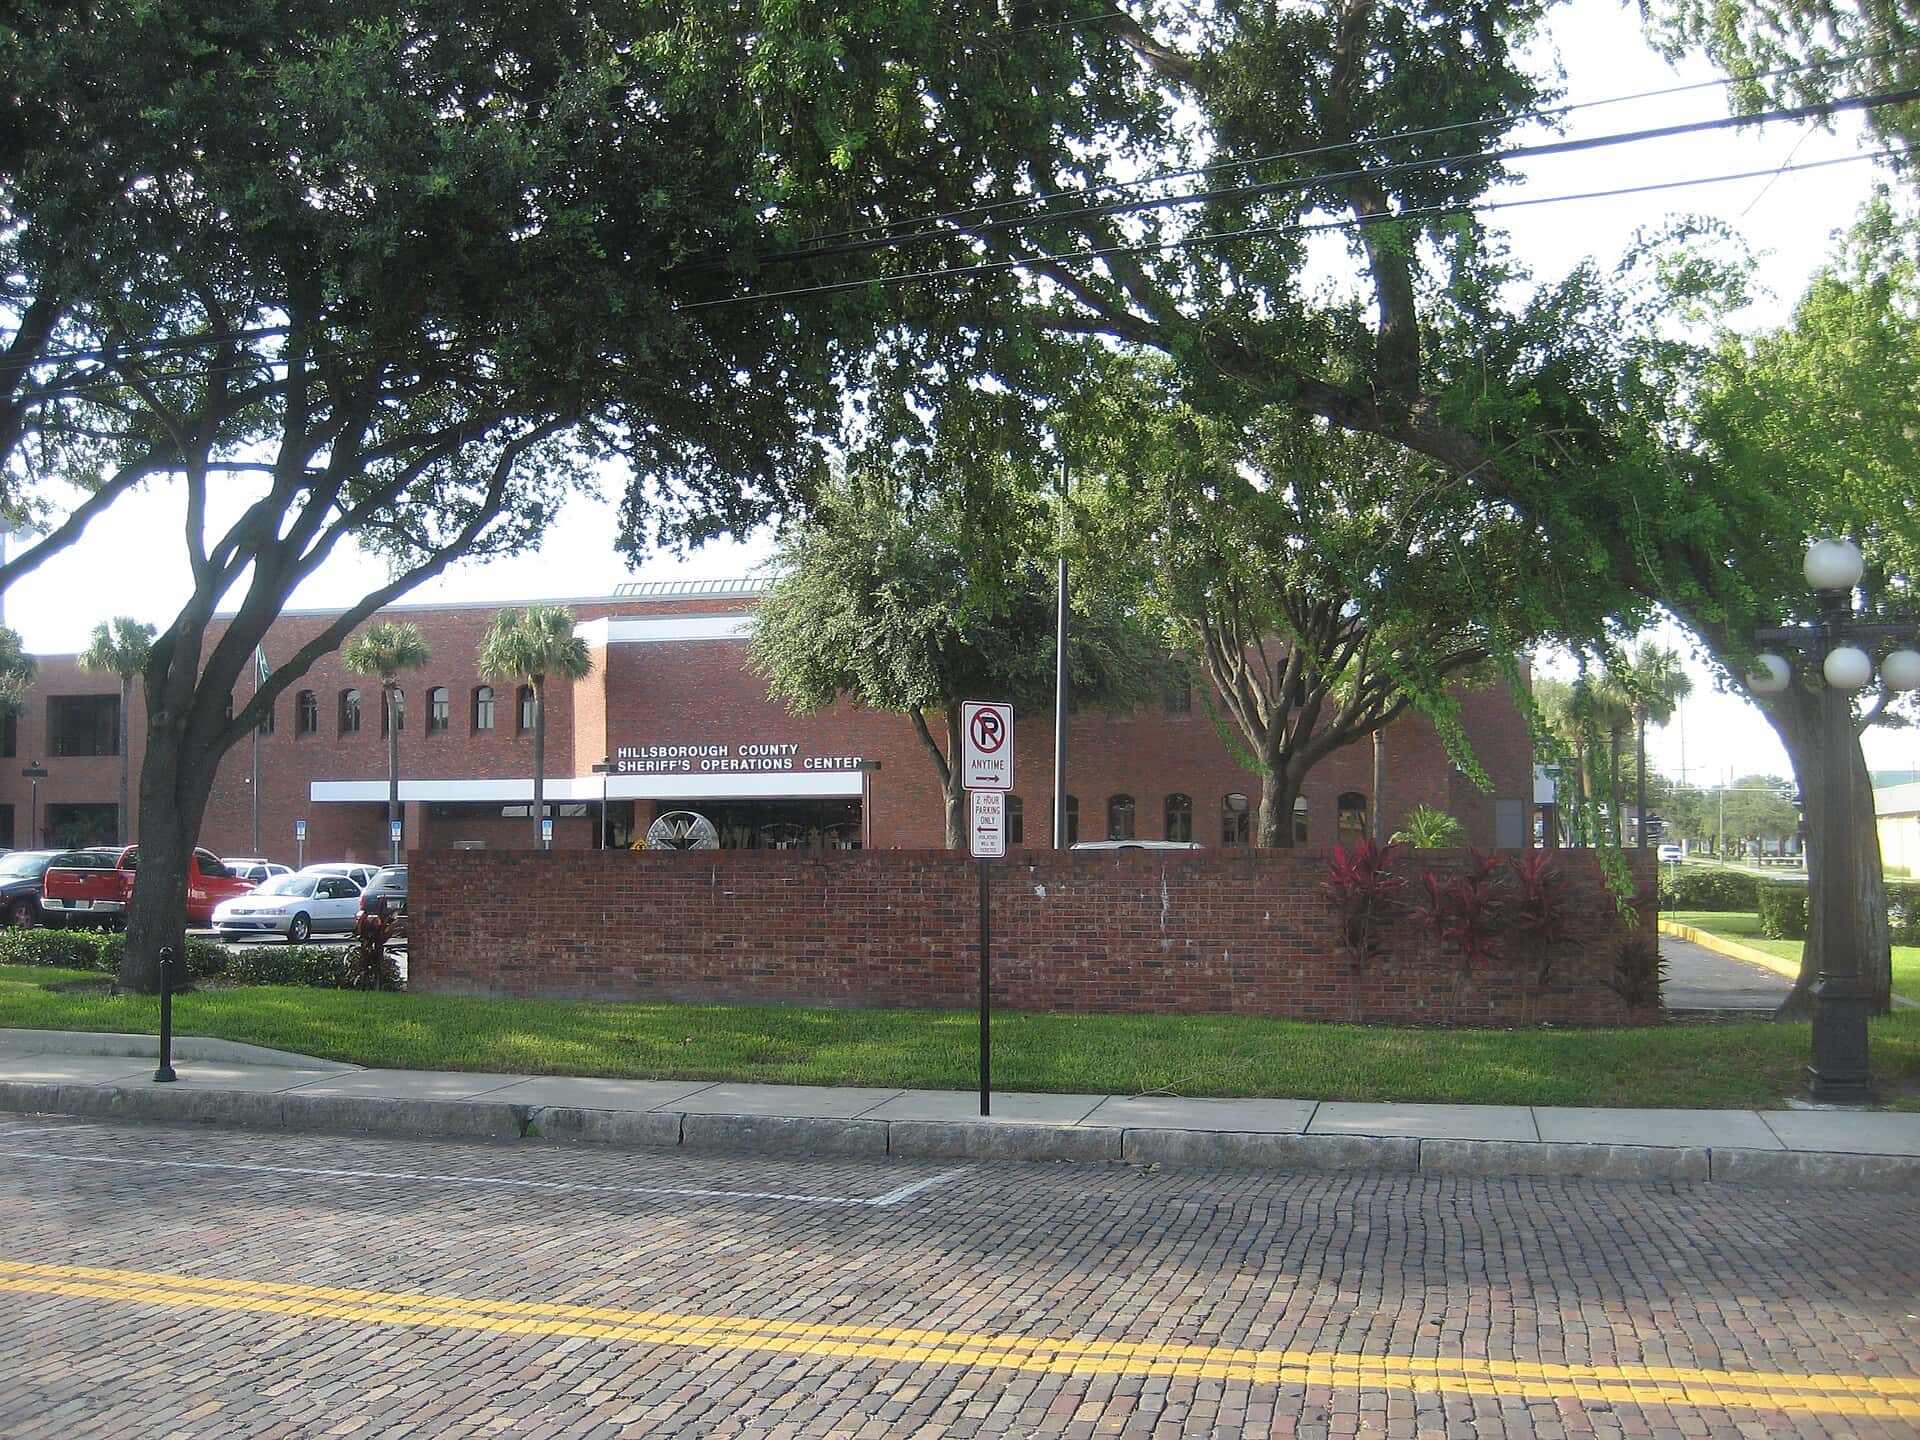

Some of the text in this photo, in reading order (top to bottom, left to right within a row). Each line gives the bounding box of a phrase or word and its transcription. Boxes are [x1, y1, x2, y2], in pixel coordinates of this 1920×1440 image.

[618, 744, 798, 758] HILLSBOROUGH COUNTY
[618, 760, 691, 772] SHERIFF'S
[700, 758, 793, 770] OPERATIONS
[971, 760, 1005, 770] ANYTIME
[976, 795, 1000, 804] 2 HOUR
[975, 805, 1000, 814] PARKING
[980, 816, 995, 825] ONLY
